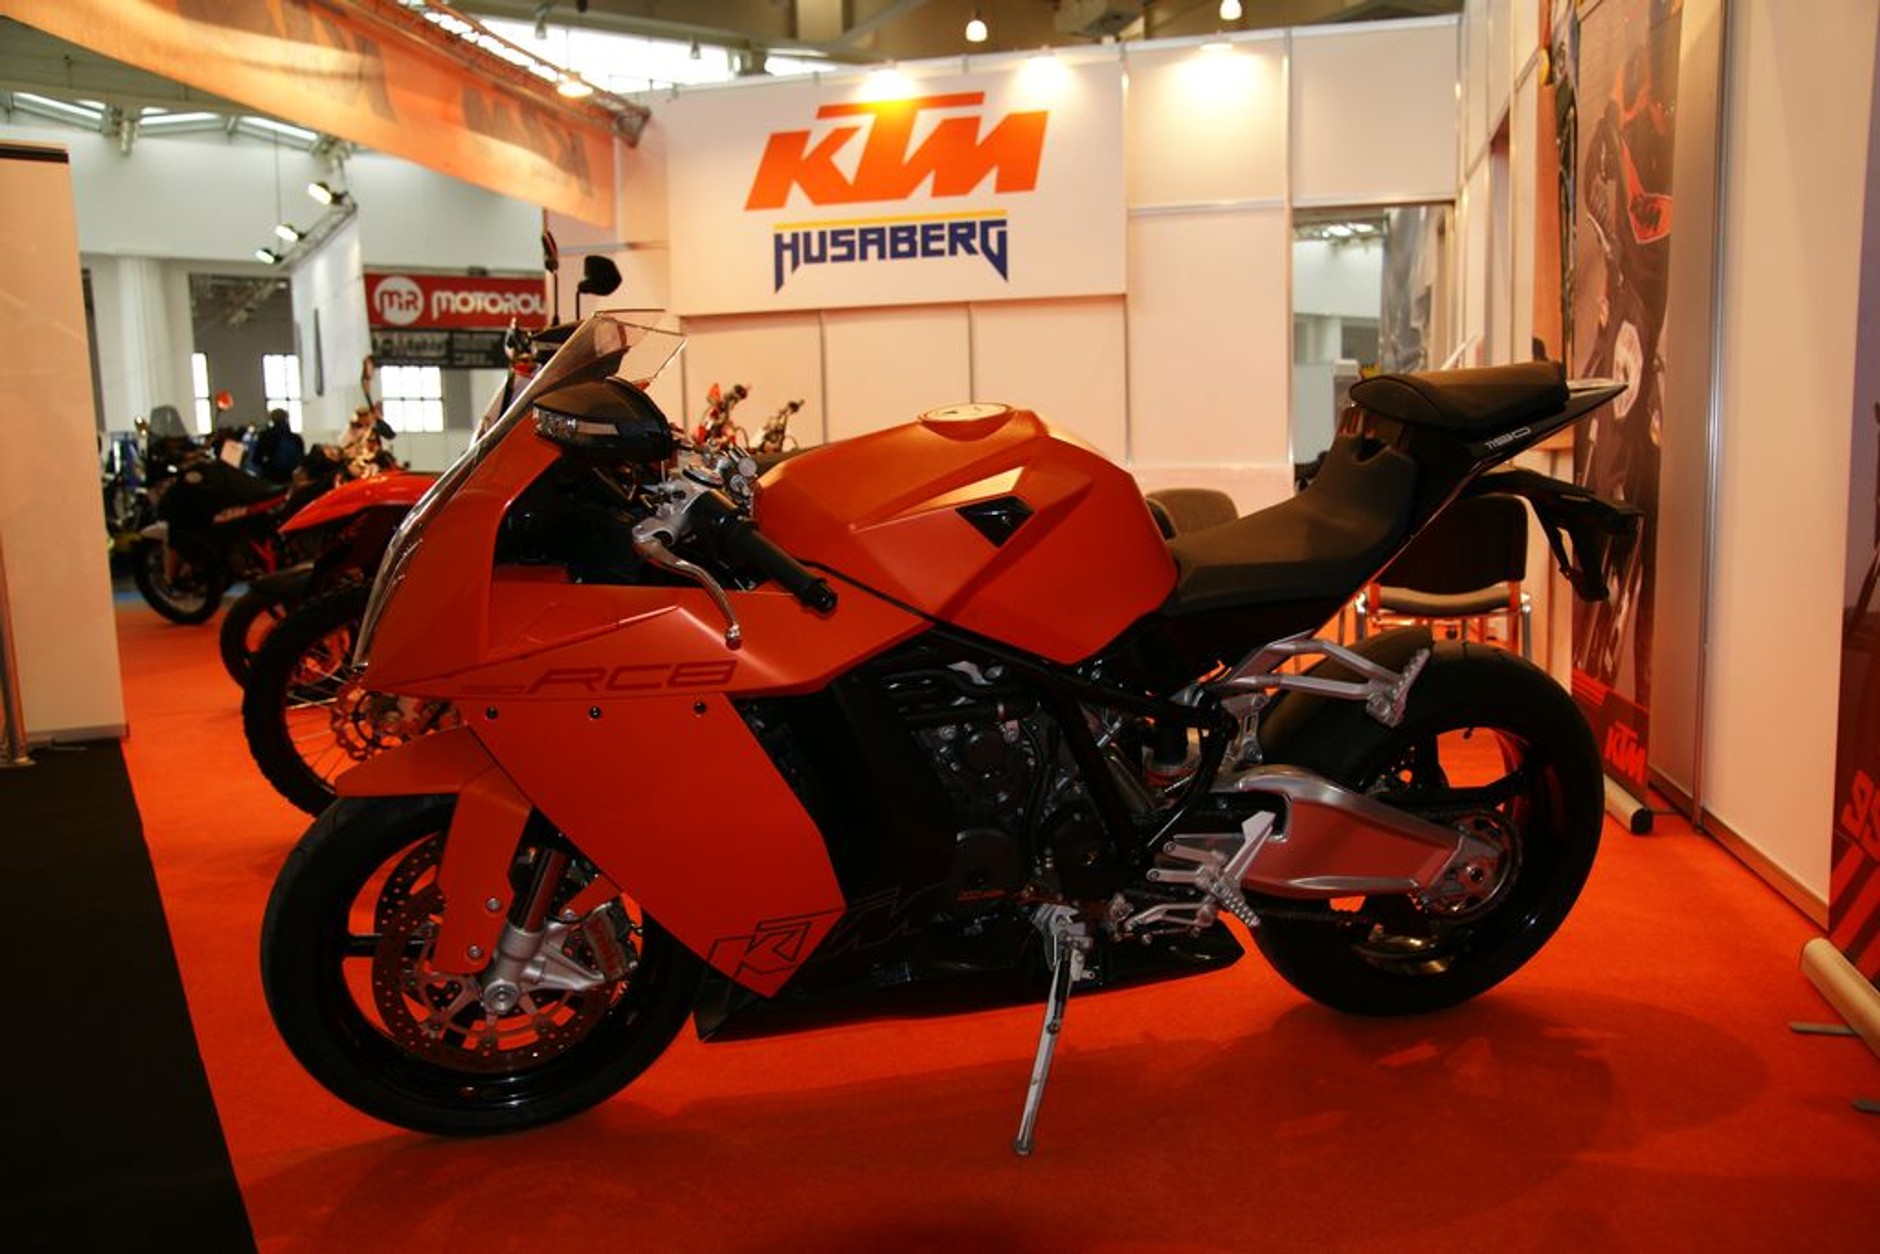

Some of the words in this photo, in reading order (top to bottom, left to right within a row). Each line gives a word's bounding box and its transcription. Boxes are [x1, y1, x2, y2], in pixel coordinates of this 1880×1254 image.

[744, 91, 1048, 211] KTM
[773, 219, 1008, 294] HUSABERG
[527, 659, 738, 695] RC8
[1604, 720, 1646, 786] KTM
